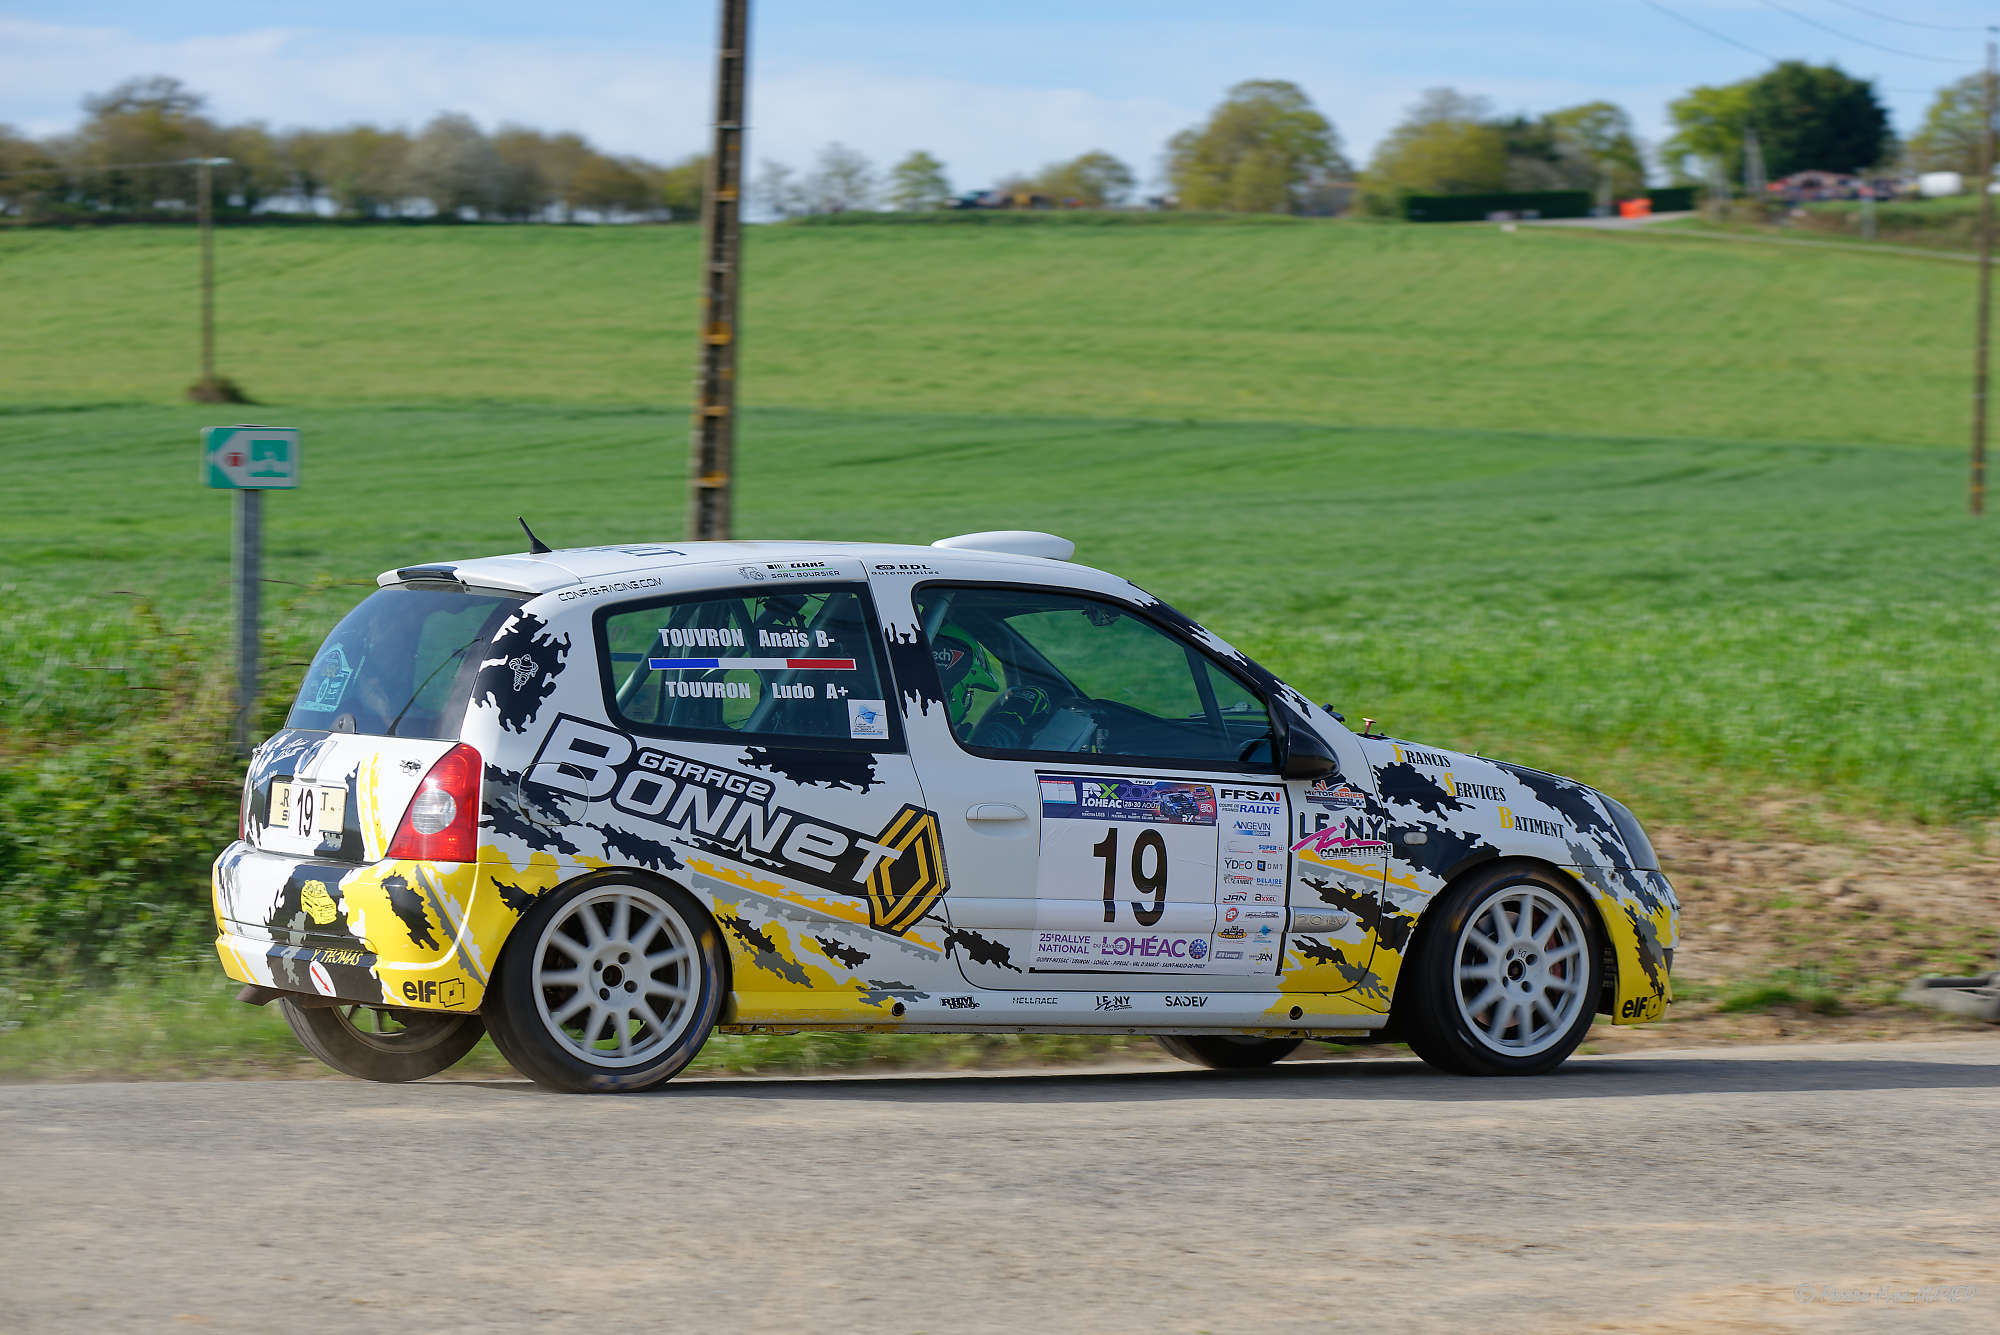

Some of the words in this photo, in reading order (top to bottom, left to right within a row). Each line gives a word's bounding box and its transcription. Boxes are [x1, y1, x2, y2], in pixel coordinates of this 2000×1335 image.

[797, 570, 840, 579] BOURSIER
[558, 577, 664, 602] CONFIG-RACING.COM
[658, 628, 745, 648] TOUVRON
[758, 629, 810, 648] Anaïs
[815, 630, 836, 648] B-
[665, 681, 751, 699] TOUVRON
[771, 682, 815, 699] Ludo
[826, 683, 849, 700] A+
[1391, 743, 1451, 768] FRANCIS
[1082, 782, 1120, 800] RX
[1220, 788, 1275, 802] FFSA
[1444, 772, 1507, 802] SERVICES
[297, 787, 314, 837] 19
[1082, 797, 1122, 809] LOHEAC
[1240, 804, 1280, 815] RALLYE
[1232, 821, 1271, 831] ANGEVIN
[1497, 805, 1564, 839] BATIMENT
[1224, 859, 1253, 870] YDEO
[1093, 827, 1168, 927] 19
[1256, 877, 1282, 885] DELAIRE
[1054, 934, 1091, 944] RALLYE
[1101, 935, 1187, 958] LOHÉAC
[320, 949, 364, 966] THOMAS
[1038, 943, 1090, 955] NATIONAL
[402, 980, 437, 1003] elf
[1165, 996, 1208, 1007] SADEV
[1622, 997, 1647, 1019] elf
